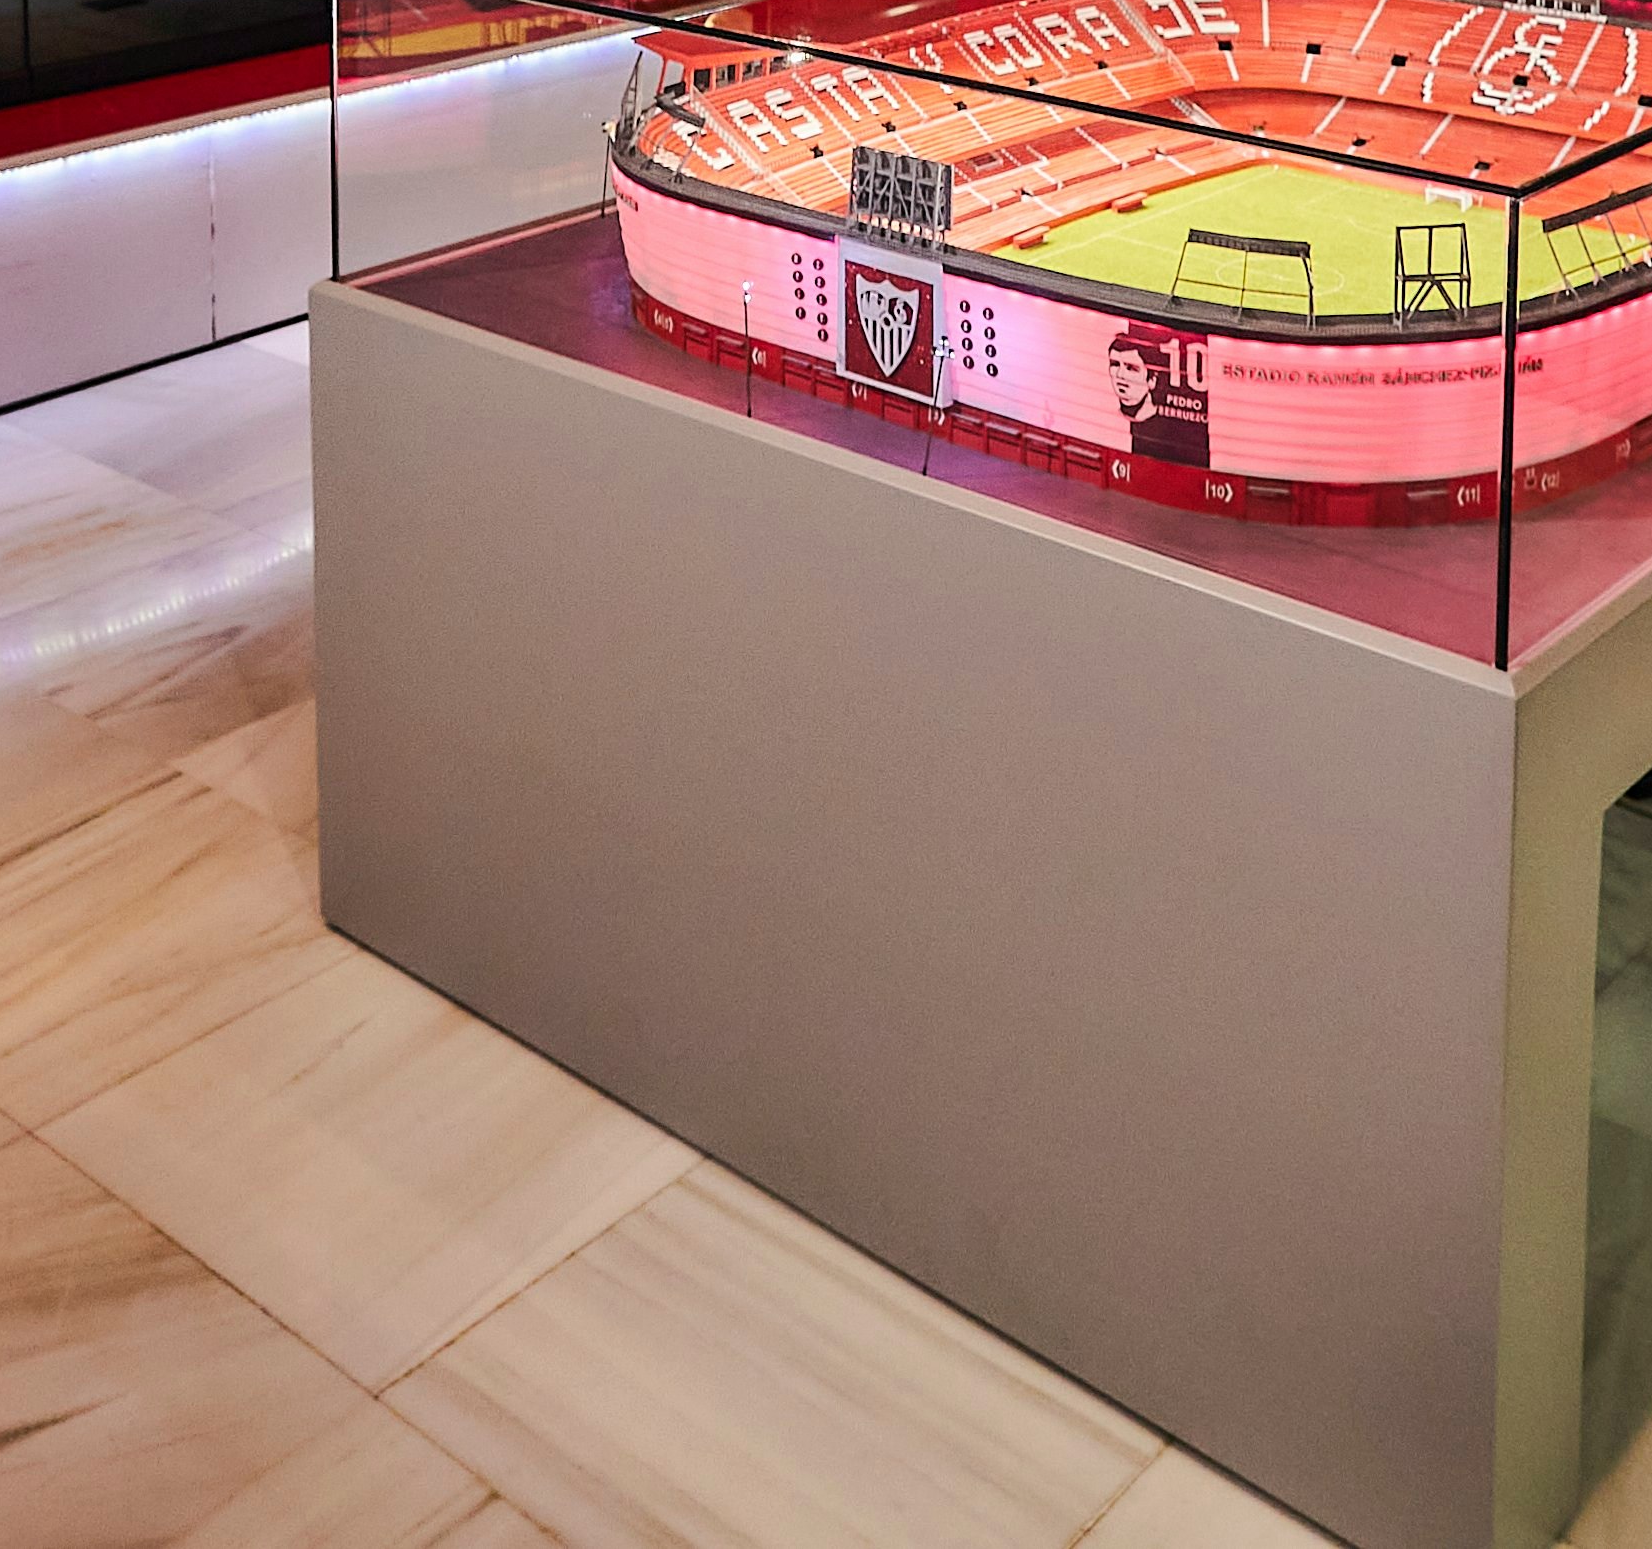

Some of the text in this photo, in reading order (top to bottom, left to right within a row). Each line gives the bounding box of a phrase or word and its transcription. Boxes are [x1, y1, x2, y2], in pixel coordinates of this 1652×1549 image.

[1159, 337, 1209, 392] 10
[1222, 363, 1299, 383] ESTADIO
[1166, 393, 1203, 411] PEDRO
